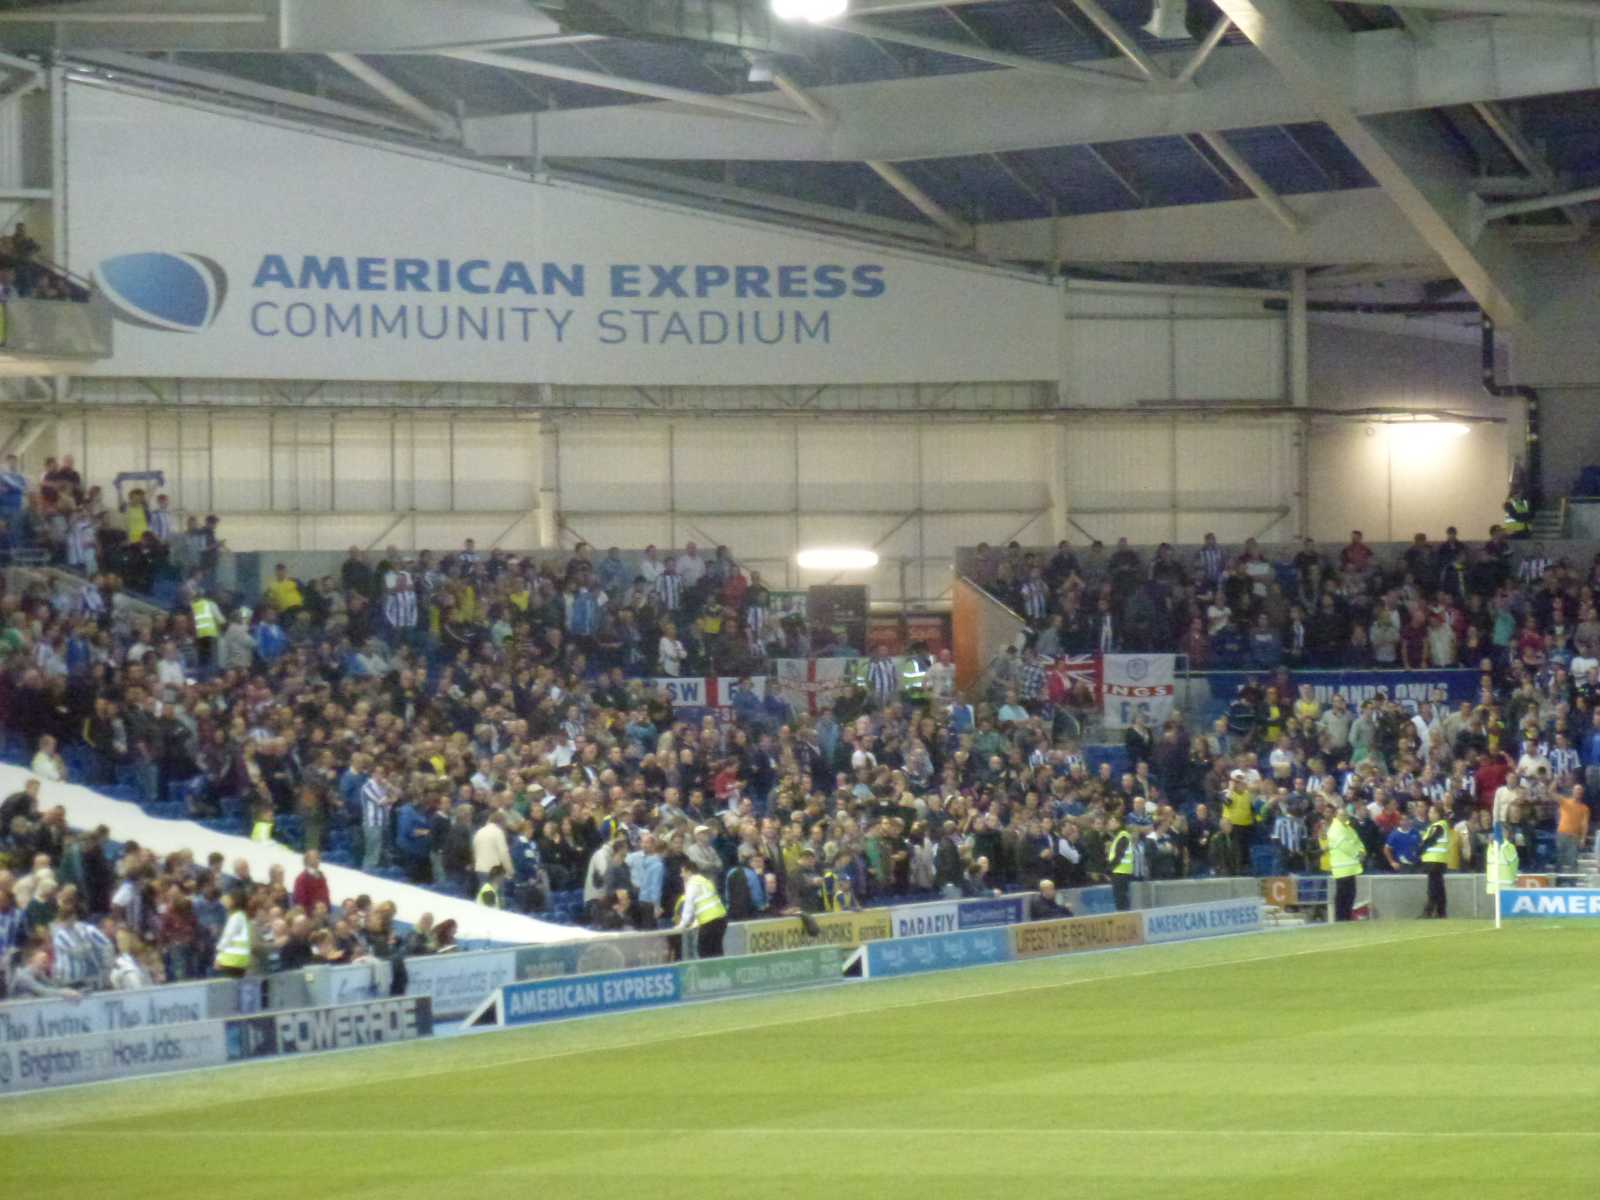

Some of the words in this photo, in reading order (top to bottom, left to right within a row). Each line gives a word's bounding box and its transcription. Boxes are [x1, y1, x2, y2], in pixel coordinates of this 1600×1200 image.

[251, 254, 585, 297] AMERICAN
[609, 264, 887, 298] EXPRESS
[251, 301, 574, 342] COMMUNITY
[597, 309, 831, 345] STADIUM
[1148, 912, 1207, 935] AMERICAN
[1209, 904, 1260, 927] EXPRESS
[509, 982, 599, 1016] AMERICAN
[602, 973, 676, 1003] EXPRESS
[275, 998, 419, 1053] POWERADE
